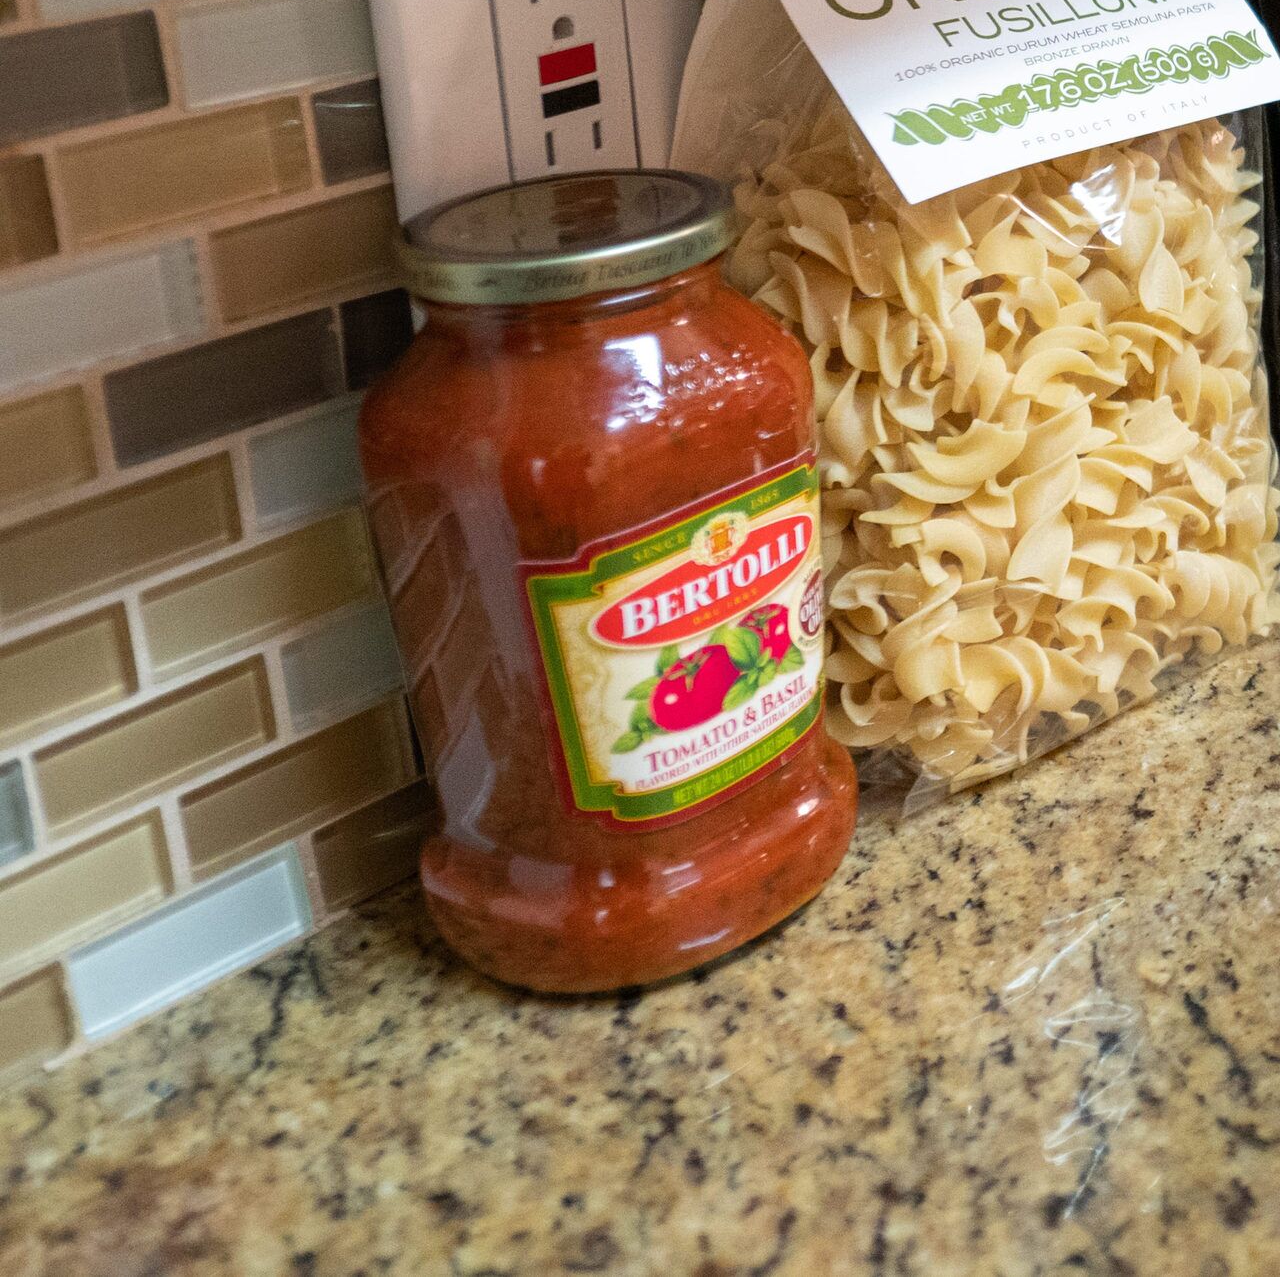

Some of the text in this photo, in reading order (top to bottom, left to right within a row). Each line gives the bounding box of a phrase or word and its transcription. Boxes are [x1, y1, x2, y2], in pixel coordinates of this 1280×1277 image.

[894, 2, 1216, 83] 100% ORGANIC DURUM WHEAT SEMOLINA PASTA
[1023, 34, 1131, 67] BRONZE DRAWN
[960, 44, 1220, 125] NET WT. 17.6 OZ. (500 G)
[1022, 94, 1210, 149] PRODUCT OF ITALY
[619, 522, 806, 639] BERTOLLI
[632, 531, 687, 562] SINCE
[645, 675, 807, 772] TOMATO & BASIL
[635, 762, 690, 790] FLAVORED
[692, 750, 718, 768] WITH
[717, 733, 749, 756] OTHER
